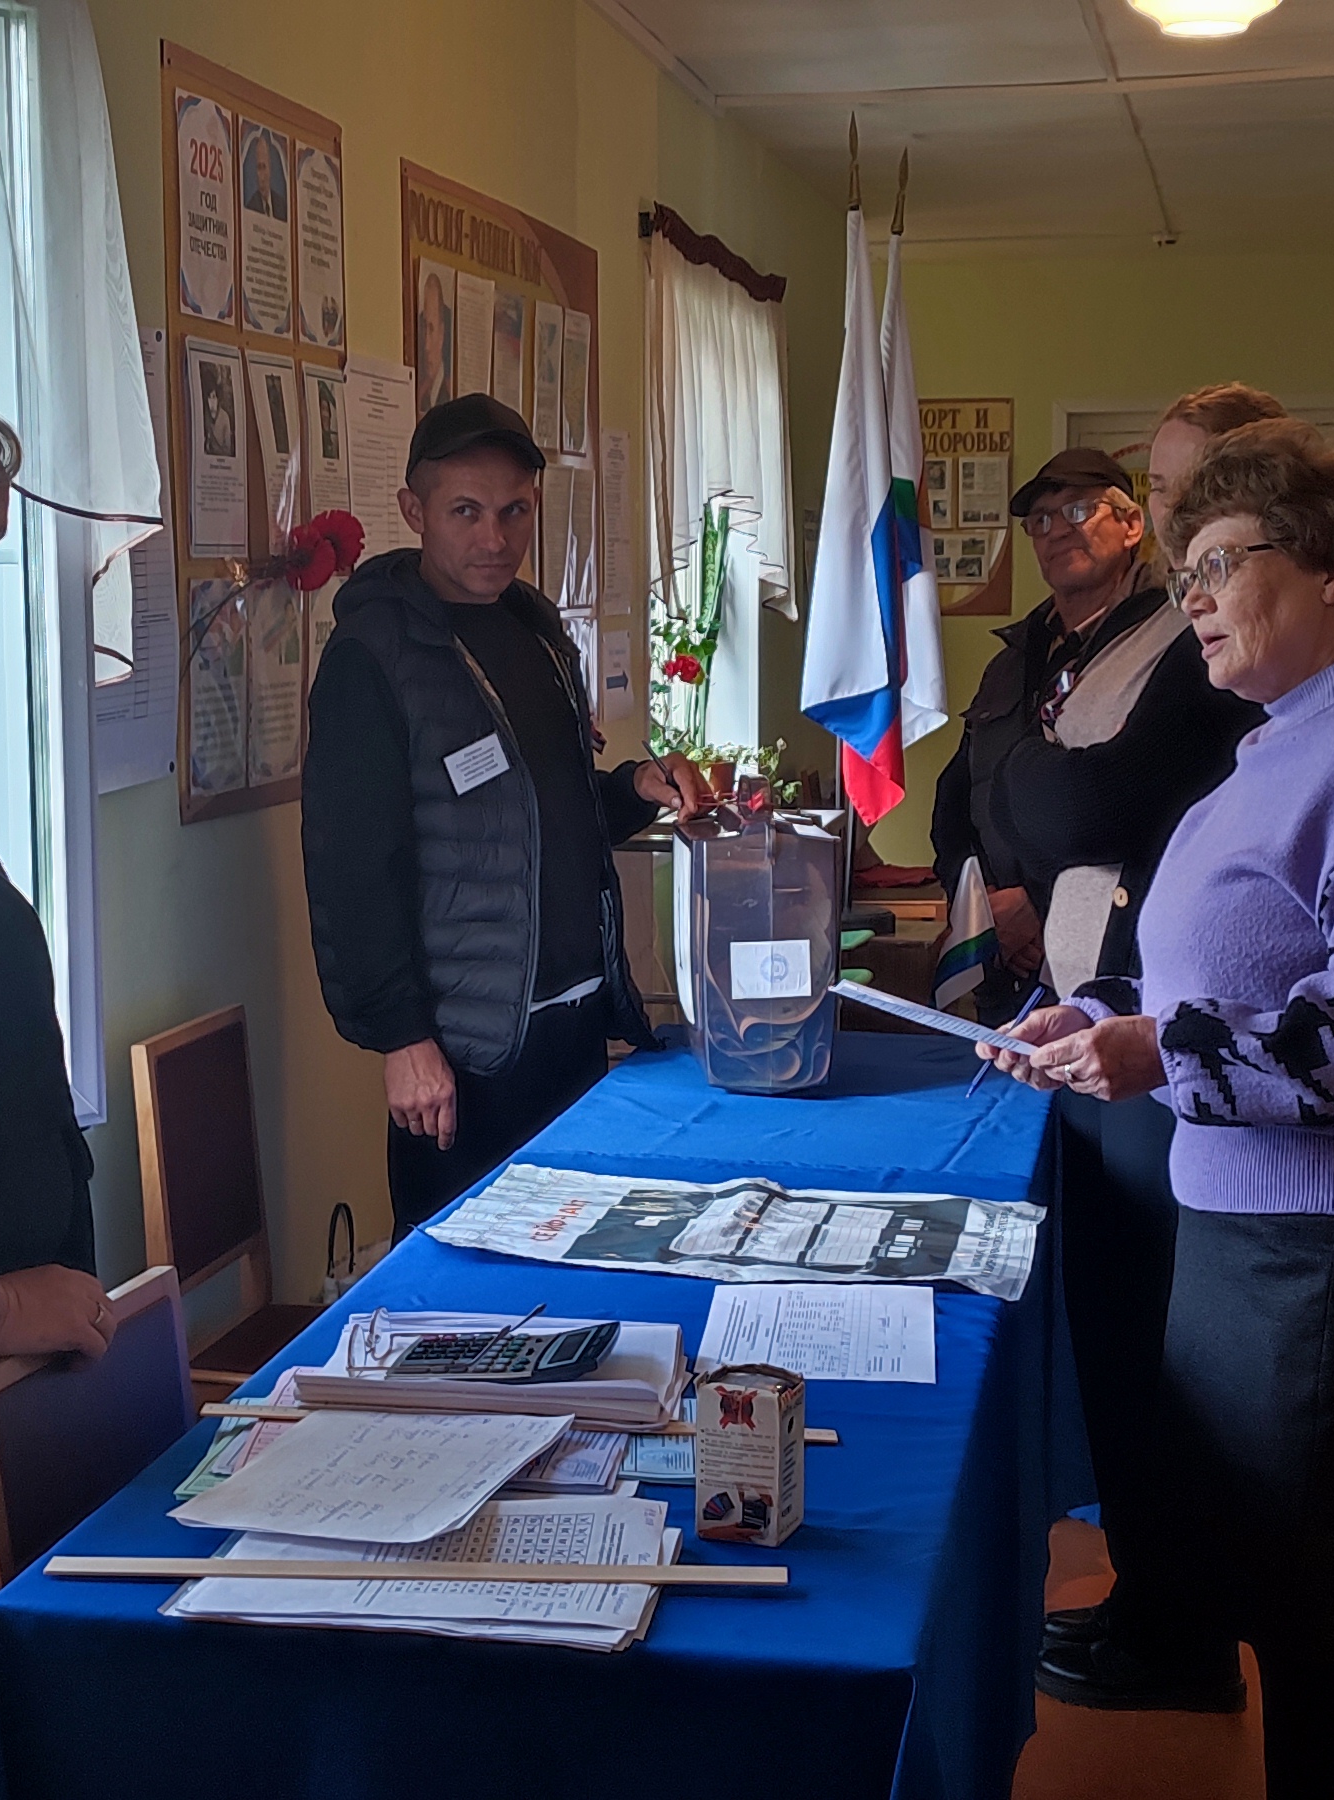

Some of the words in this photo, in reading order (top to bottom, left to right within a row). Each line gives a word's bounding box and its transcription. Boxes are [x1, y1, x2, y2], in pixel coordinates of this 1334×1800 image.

[189, 137, 224, 184] 2025
[199, 190, 218, 215] ГОД
[187, 210, 229, 239] ЗАЩИТНИКА
[189, 235, 228, 262] ОТЕЧЕСТВА
[919, 408, 961, 430] ОРТ
[974, 407, 990, 429] И
